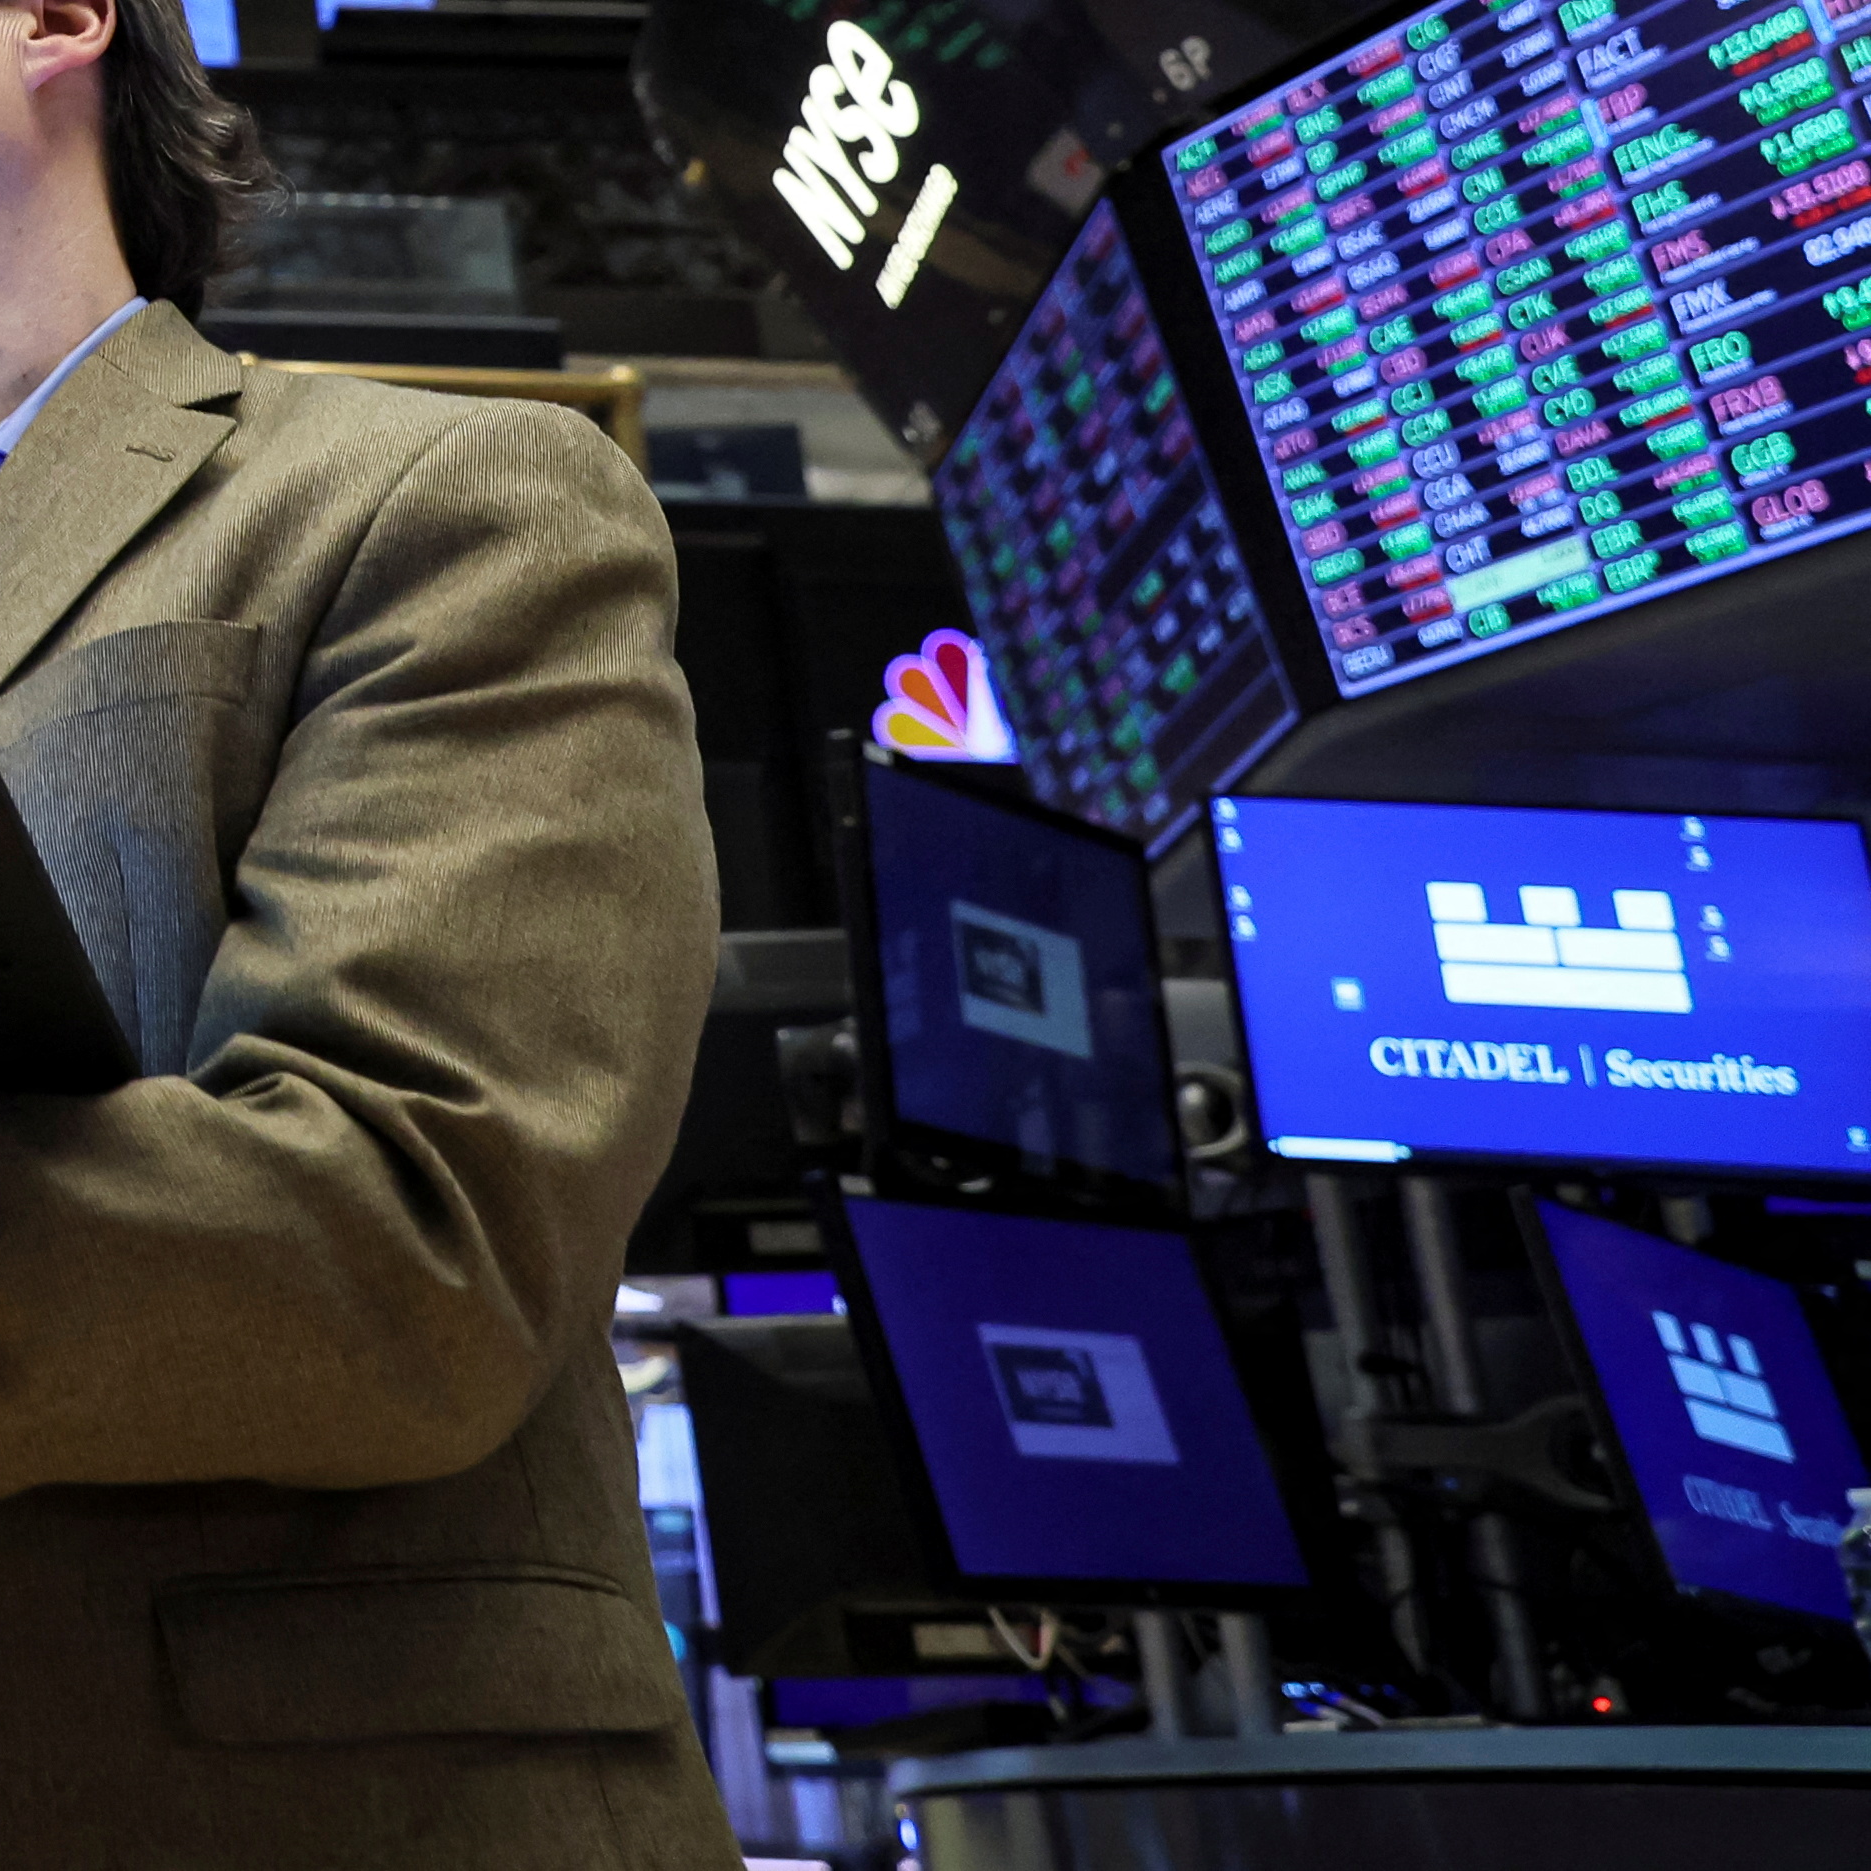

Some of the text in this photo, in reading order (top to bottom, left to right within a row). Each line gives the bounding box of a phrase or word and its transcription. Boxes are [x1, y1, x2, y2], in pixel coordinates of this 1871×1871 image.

[1160, 34, 1211, 91] 6P
[770, 18, 922, 269] NYSE
[1689, 330, 1750, 374] FRO
[1751, 479, 1828, 528] GLOB
[1369, 1037, 1799, 1097] CITADEL Securities
